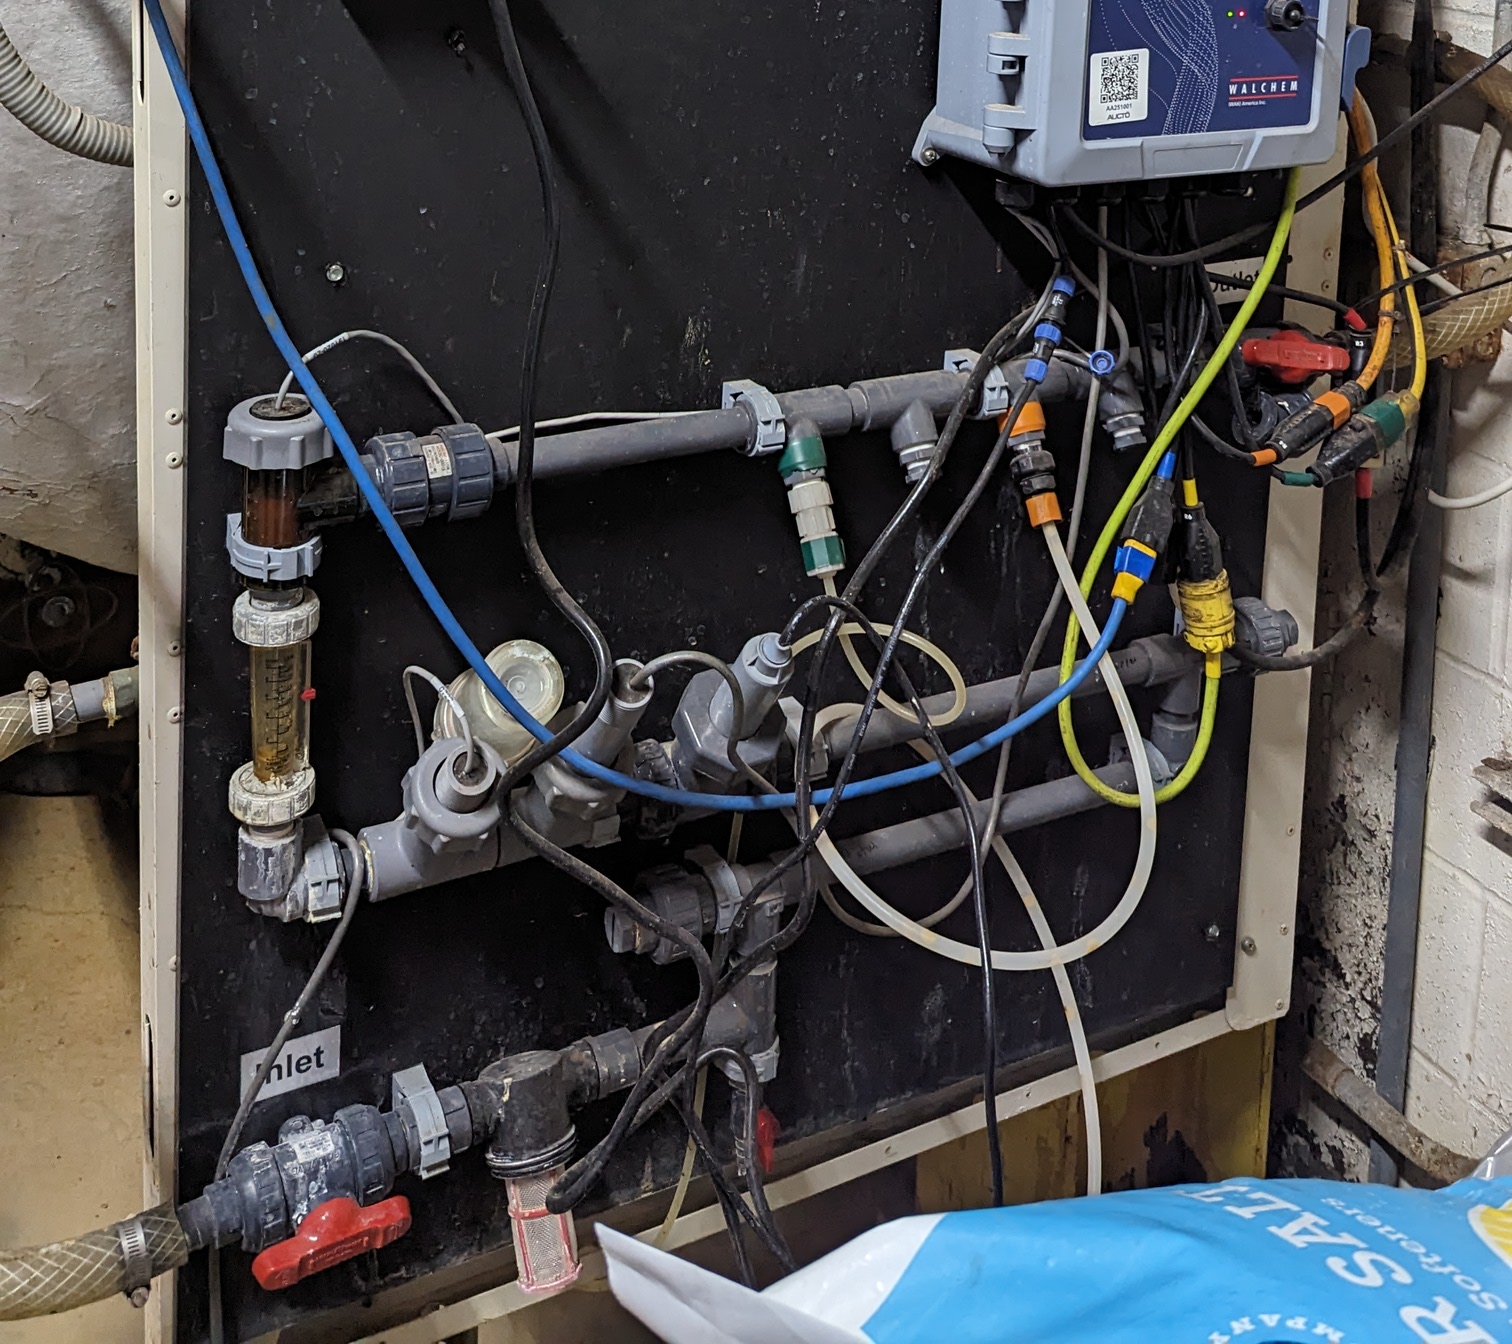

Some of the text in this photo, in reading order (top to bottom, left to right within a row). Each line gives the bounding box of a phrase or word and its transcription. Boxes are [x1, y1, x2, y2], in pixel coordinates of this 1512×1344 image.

[1229, 81, 1298, 95] WALCHEM
[1176, 1184, 1414, 1288] SALT
[1320, 1197, 1508, 1311] Softeners
